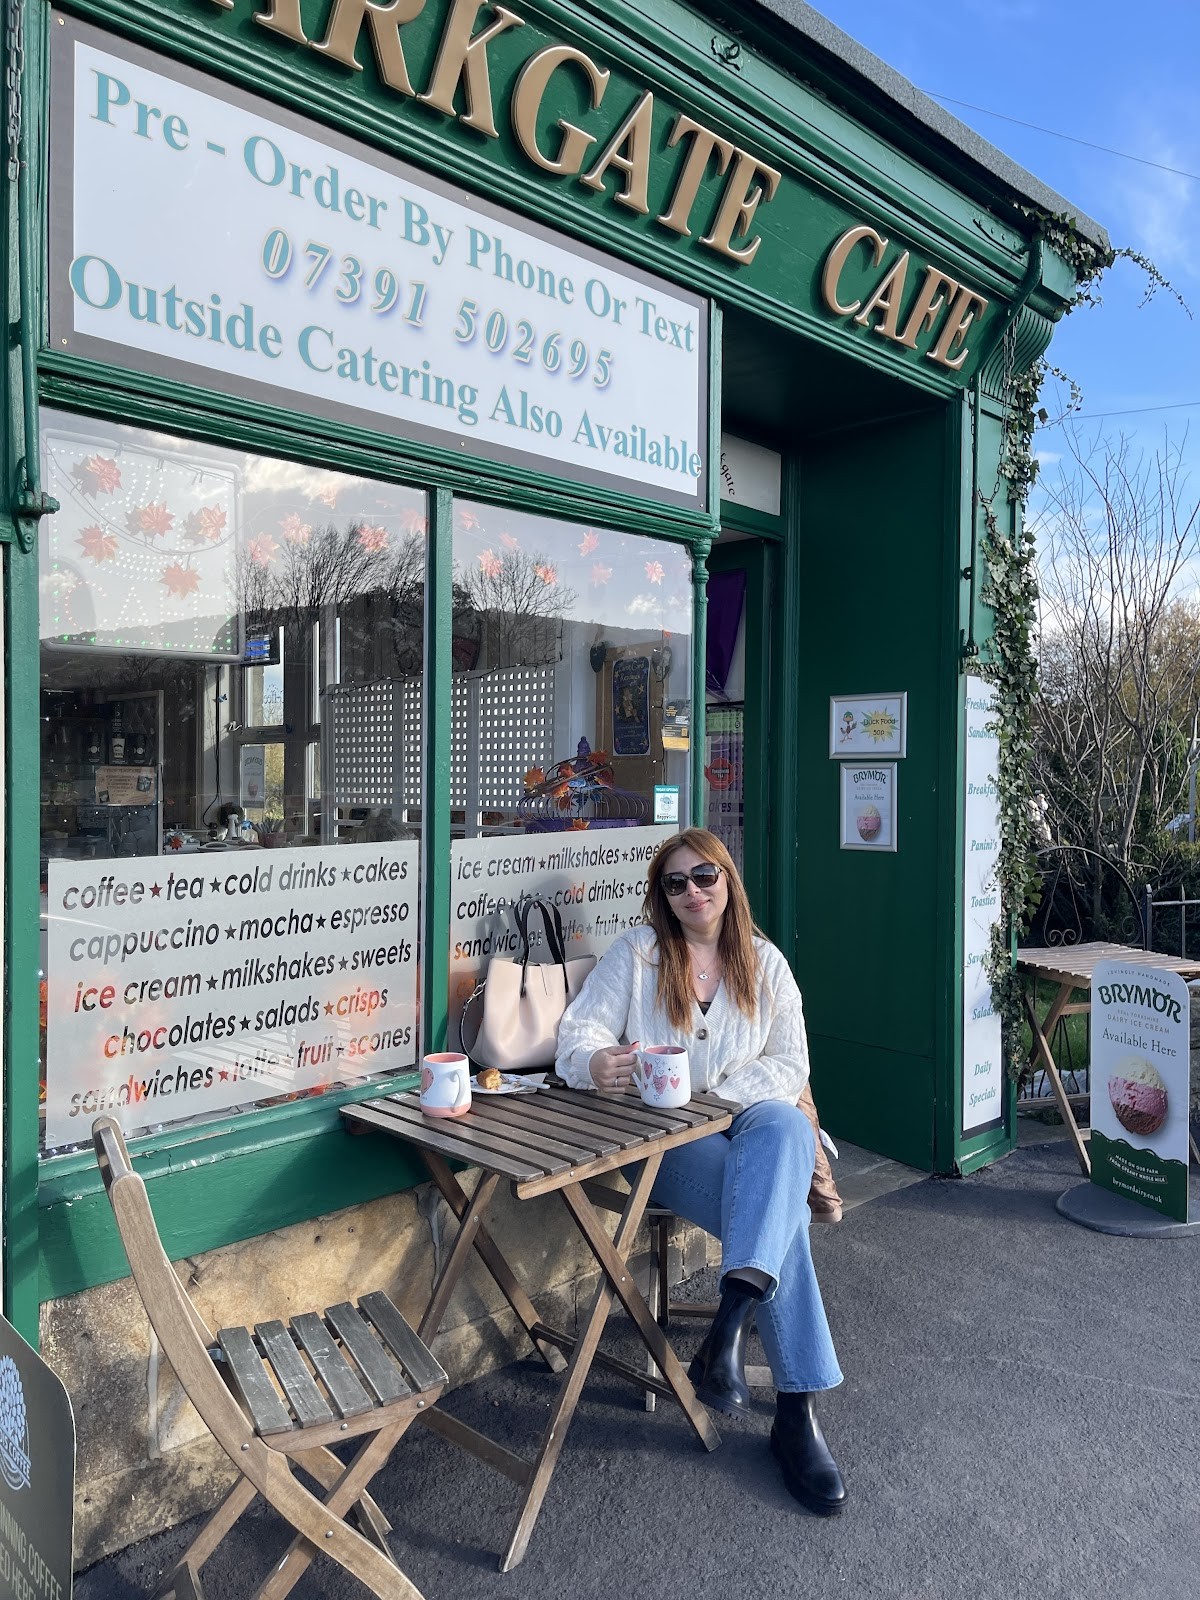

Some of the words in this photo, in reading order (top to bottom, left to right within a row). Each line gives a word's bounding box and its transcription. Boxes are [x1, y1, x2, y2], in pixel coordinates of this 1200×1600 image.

[90, 69, 189, 151] Pre
[243, 135, 388, 230] Order
[401, 196, 454, 264] By
[466, 225, 574, 305] Phone
[584, 279, 627, 325] Or
[634, 303, 694, 353] Text
[261, 226, 427, 328] 07391
[453, 298, 613, 388] 502695
[821, 224, 988, 371] CAFE
[69, 255, 282, 360] Outside
[298, 325, 479, 425] Catering
[489, 384, 563, 439] Also
[572, 410, 702, 478] Available
[457, 856, 482, 880] ice
[487, 856, 535, 877] cream
[547, 845, 619, 870] milkshakes
[971, 839, 998, 852] Panini's
[62, 876, 145, 911] coffee
[167, 873, 205, 901] tea
[224, 865, 273, 896] cold
[279, 861, 337, 890] drinks
[353, 857, 408, 883] cakes
[457, 893, 505, 919] coffee
[554, 882, 585, 907] cold
[588, 880, 625, 903] drinks
[971, 896, 996, 908] Toasties
[69, 918, 220, 965] cappuccino
[239, 908, 312, 941] mocha
[330, 902, 409, 934] espresso
[595, 913, 619, 937] fruit
[74, 982, 116, 1013] ice
[123, 971, 201, 1006] cream
[220, 951, 335, 992] milkshakes
[351, 939, 412, 971] sweets
[104, 1010, 236, 1059] chocolates
[254, 997, 319, 1032] salads
[336, 986, 388, 1017] crisps
[973, 1006, 993, 1020] Salads
[1098, 984, 1181, 1024] BRYMOR
[1103, 1027, 1148, 1050] Available
[1152, 1040, 1177, 1057] Here
[1130, 1020, 1142, 1028] ICE
[1145, 1023, 1170, 1035] CREAM
[69, 1064, 214, 1118] sandwiches
[232, 1049, 280, 1082] latte
[297, 1036, 334, 1068] fruit
[347, 1024, 411, 1057] scones
[974, 1060, 992, 1076] Daily
[969, 1088, 996, 1107] Specials
[28, 1543, 62, 1600] COFFEE
